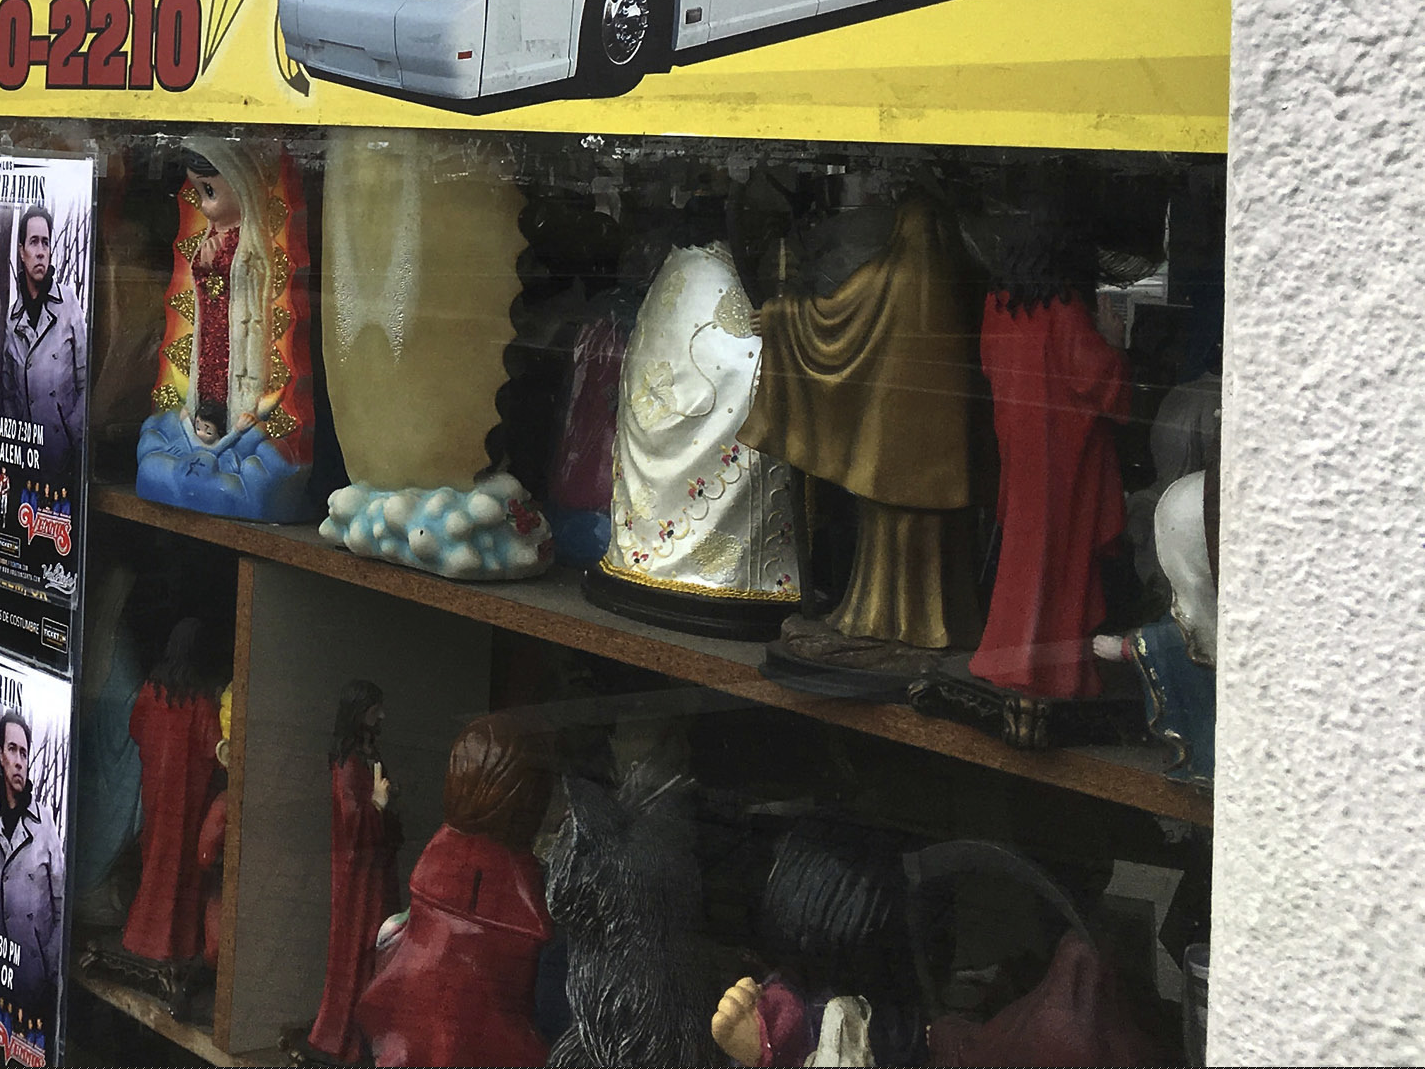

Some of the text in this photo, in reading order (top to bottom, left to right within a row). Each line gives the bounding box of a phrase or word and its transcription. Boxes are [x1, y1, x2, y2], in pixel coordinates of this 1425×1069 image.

[18, 421, 31, 443] 7:30
[33, 424, 44, 445] PM
[27, 448, 39, 469] OR
[9, 940, 21, 966] PM
[0, 964, 14, 990] OR
